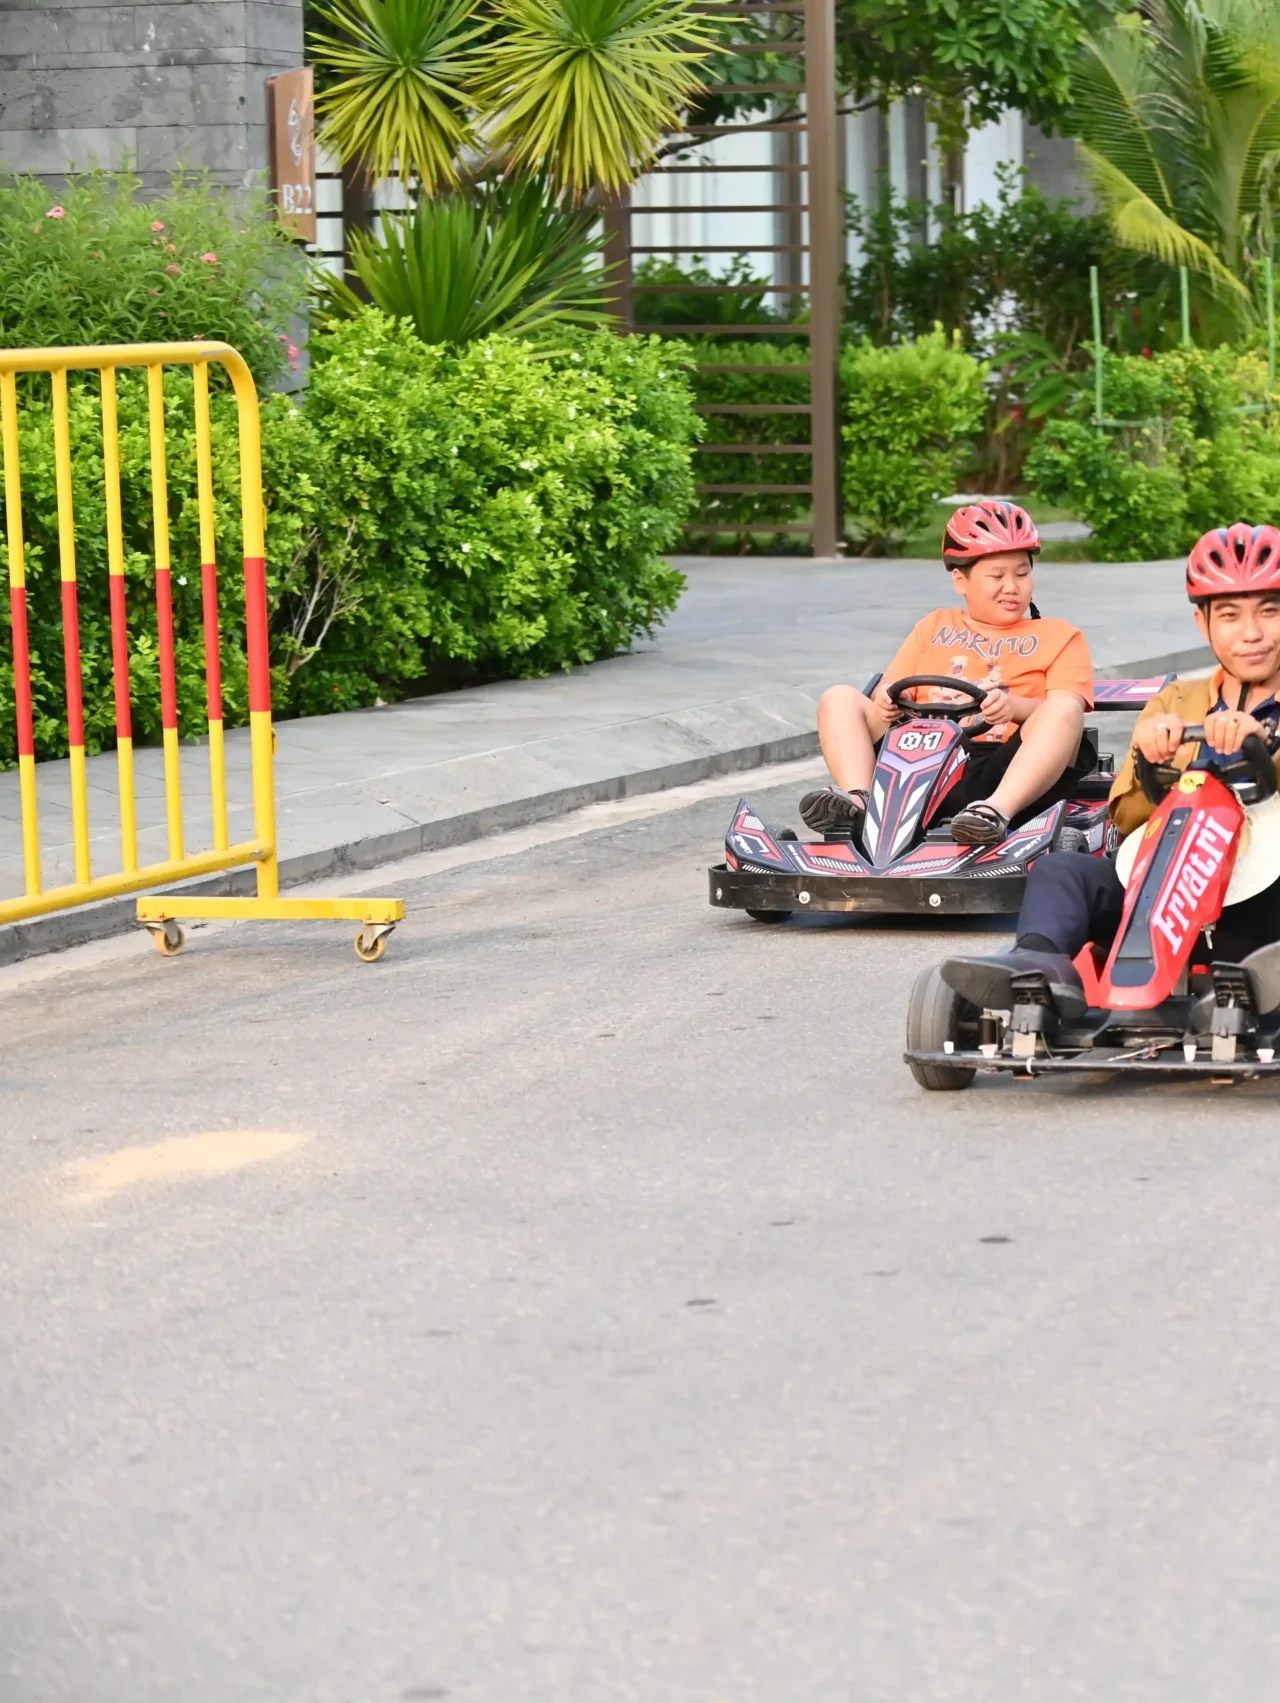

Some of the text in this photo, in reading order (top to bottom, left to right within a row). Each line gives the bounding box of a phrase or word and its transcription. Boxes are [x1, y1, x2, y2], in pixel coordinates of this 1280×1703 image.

[282, 183, 312, 214] B22
[931, 625, 1039, 660] NARUTO
[897, 731, 943, 751] 01
[1013, 834, 1043, 858] SPORT
